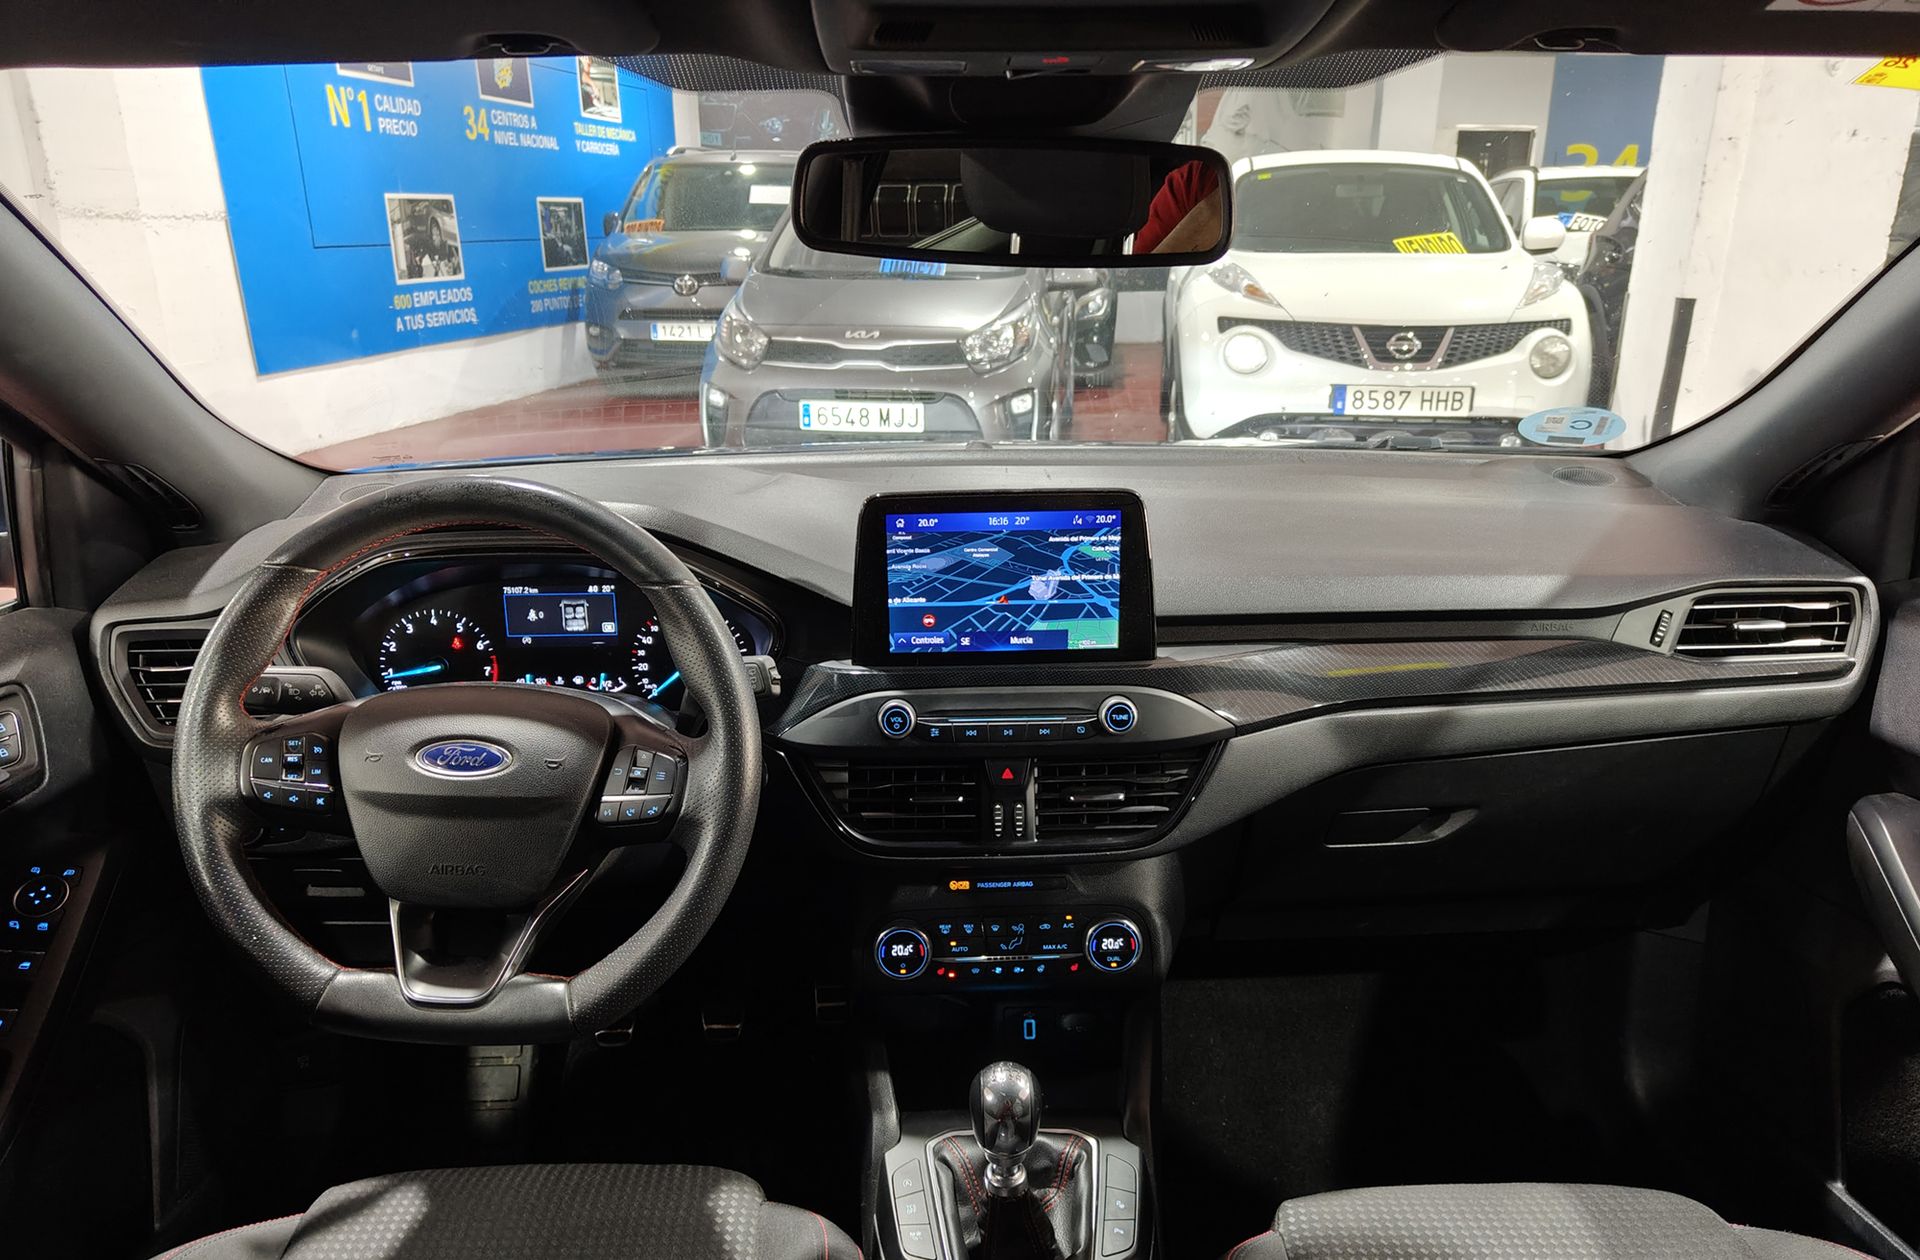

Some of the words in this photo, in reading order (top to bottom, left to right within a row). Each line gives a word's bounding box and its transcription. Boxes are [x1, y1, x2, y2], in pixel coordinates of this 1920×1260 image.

[374, 94, 421, 117] CALIDAD
[463, 105, 490, 141] 34
[491, 109, 529, 129] CENTROS
[530, 115, 537, 130] A
[378, 117, 418, 137] PRECIO
[573, 122, 597, 137] TALLER
[599, 125, 607, 139] DE
[494, 130, 519, 146] NIVEL
[520, 133, 560, 151] NACIONAL
[393, 294, 413, 310] 600
[413, 287, 473, 308] EMPLEADOS
[396, 317, 404, 332] A
[405, 315, 425, 331] TUS
[427, 308, 477, 329] SERVICIOS
[661, 325, 693, 338] 1421
[1352, 390, 1412, 410] 8587
[1420, 390, 1465, 411] HHB
[817, 407, 870, 427] 6548
[879, 407, 918, 428] MJJ
[988, 517, 1009, 526] 16:16
[430, 616, 438, 626] 4
[1530, 622, 1575, 632] AIRBAG
[406, 623, 414, 634] 3
[456, 622, 464, 633] 5
[476, 640, 484, 650] 6
[642, 636, 653, 645] 40
[911, 637, 944, 645] Controles
[1010, 636, 1034, 645] Murcia
[389, 642, 397, 652] 2
[387, 667, 394, 676] 1
[483, 666, 491, 677] 7
[638, 663, 649, 671] 20
[436, 746, 487, 766] Ford
[427, 863, 486, 876] AIRBAG
[1012, 880, 1034, 888] AIRBAG
